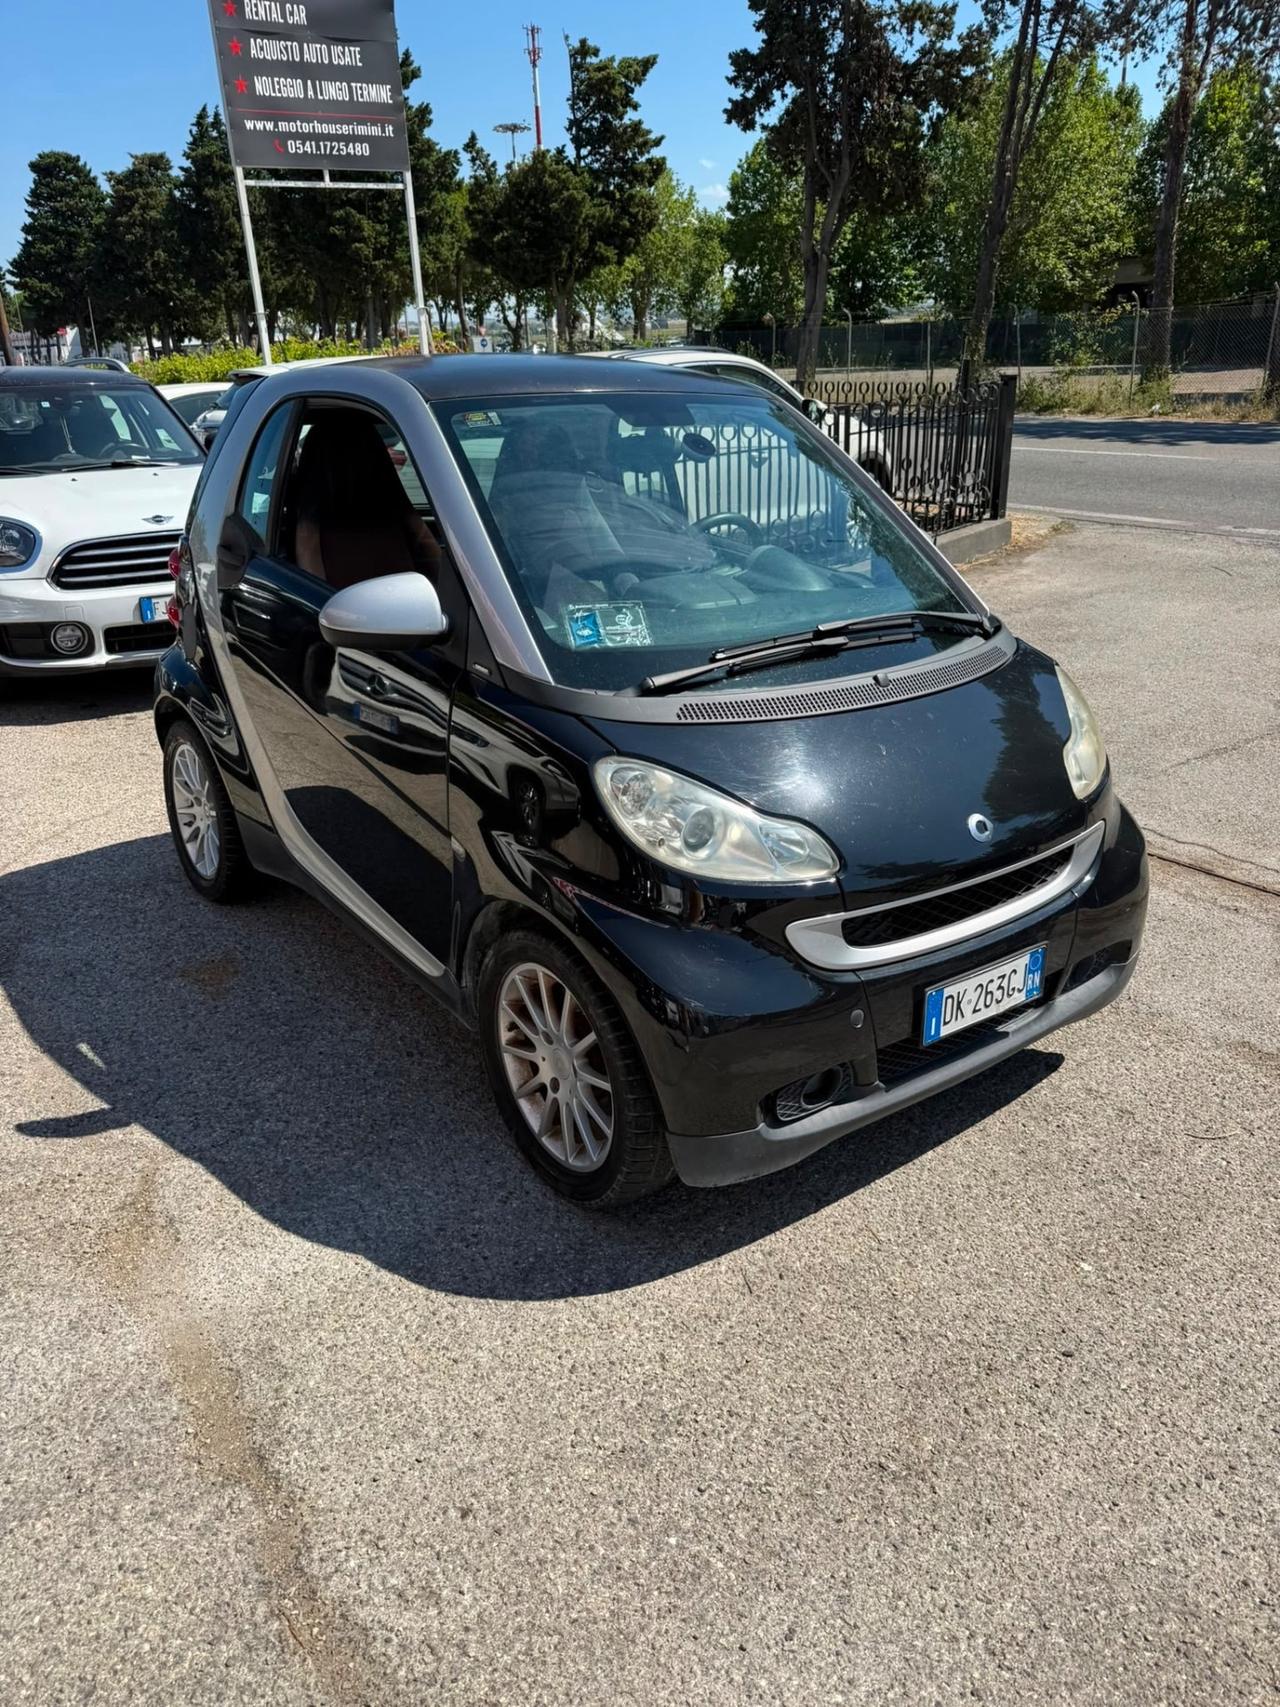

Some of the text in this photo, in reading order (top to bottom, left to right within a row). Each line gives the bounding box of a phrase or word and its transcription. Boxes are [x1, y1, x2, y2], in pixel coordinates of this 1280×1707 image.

[244, 0, 307, 25] RENTAL CAR
[250, 38, 363, 67] ACQUISTO AUTO USATE
[254, 76, 393, 104] NOLEGGIO A LUNGO TERMINE
[244, 119, 394, 137] www.motorhouserimini.it
[287, 140, 370, 156] 0541.1725480
[1027, 971, 1041, 990] RN
